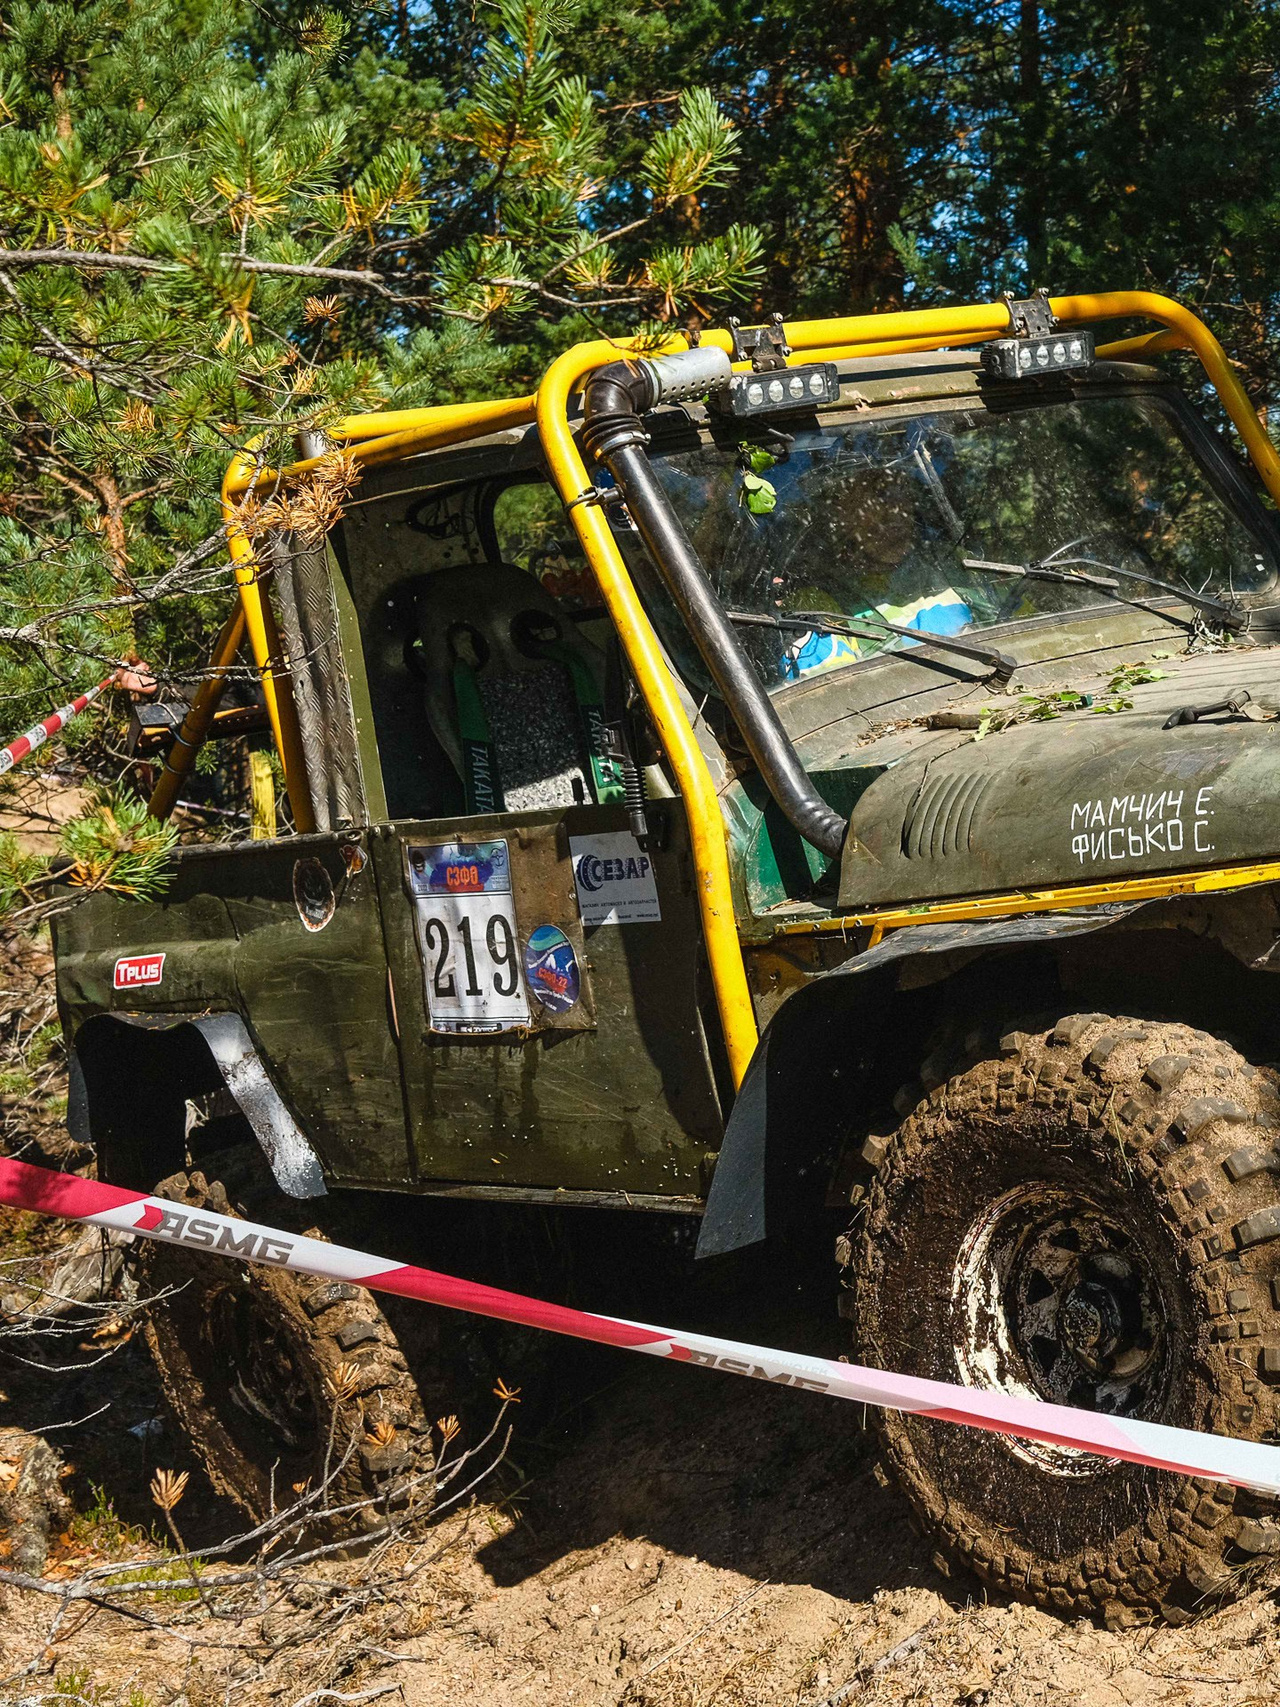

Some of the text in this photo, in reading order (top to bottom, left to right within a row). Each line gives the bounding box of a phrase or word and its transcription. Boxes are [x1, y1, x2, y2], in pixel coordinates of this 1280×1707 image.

[471, 747, 495, 815] TAKATA
[1071, 787, 1214, 830] МАМЧИЧ Е.
[1072, 819, 1215, 864] ФИСЬКО С.
[589, 857, 649, 882] СЕЗАР
[118, 963, 159, 982] TPLUS
[426, 914, 518, 997] 219
[151, 1209, 295, 1265] ASMG
